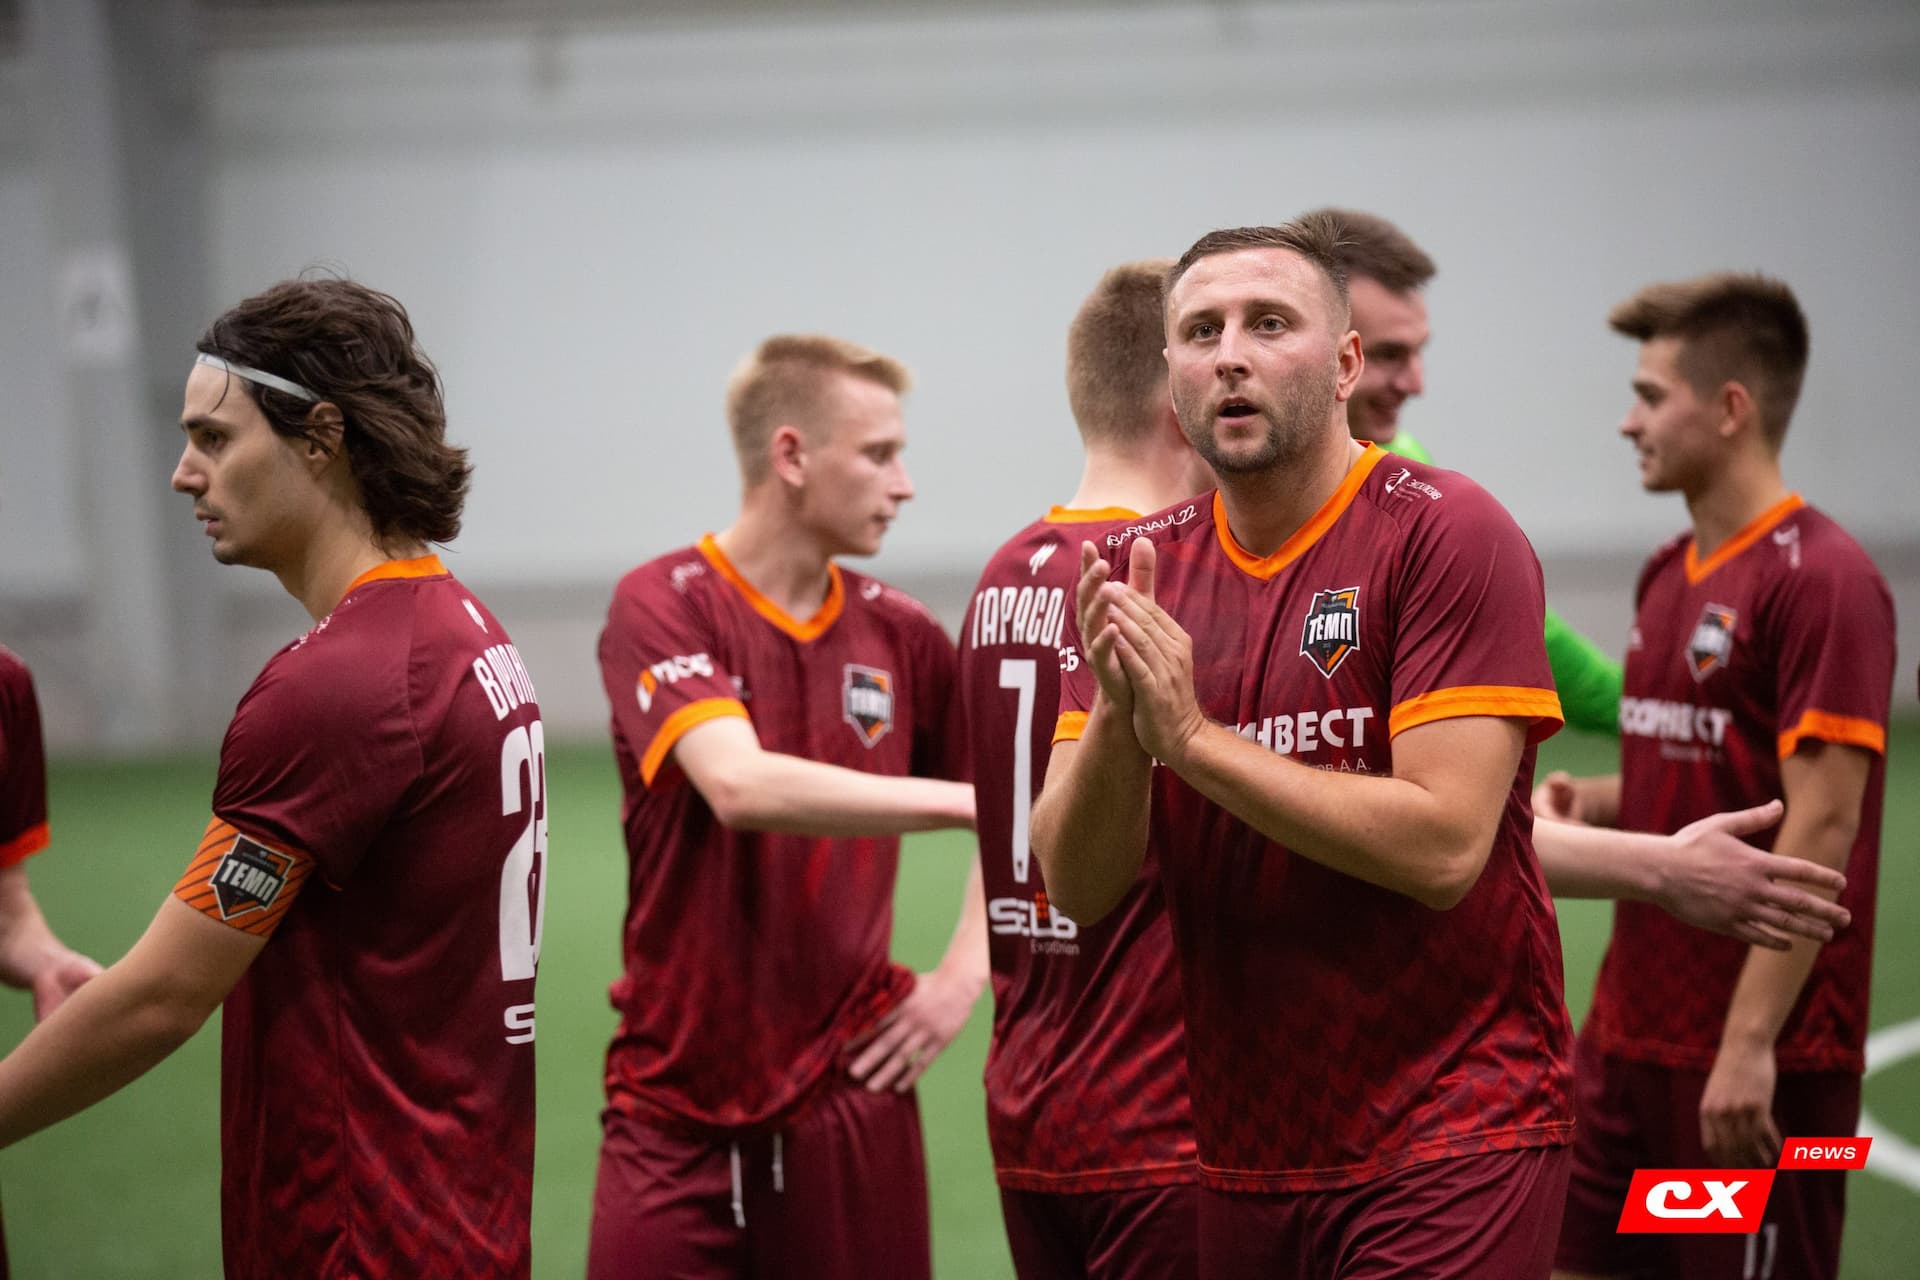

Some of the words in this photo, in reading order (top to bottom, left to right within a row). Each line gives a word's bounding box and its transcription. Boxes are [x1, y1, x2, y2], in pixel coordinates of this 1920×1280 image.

[1308, 612, 1353, 645] ТЕМП
[999, 659, 1037, 884] 7
[220, 858, 279, 902] ТЕМП
